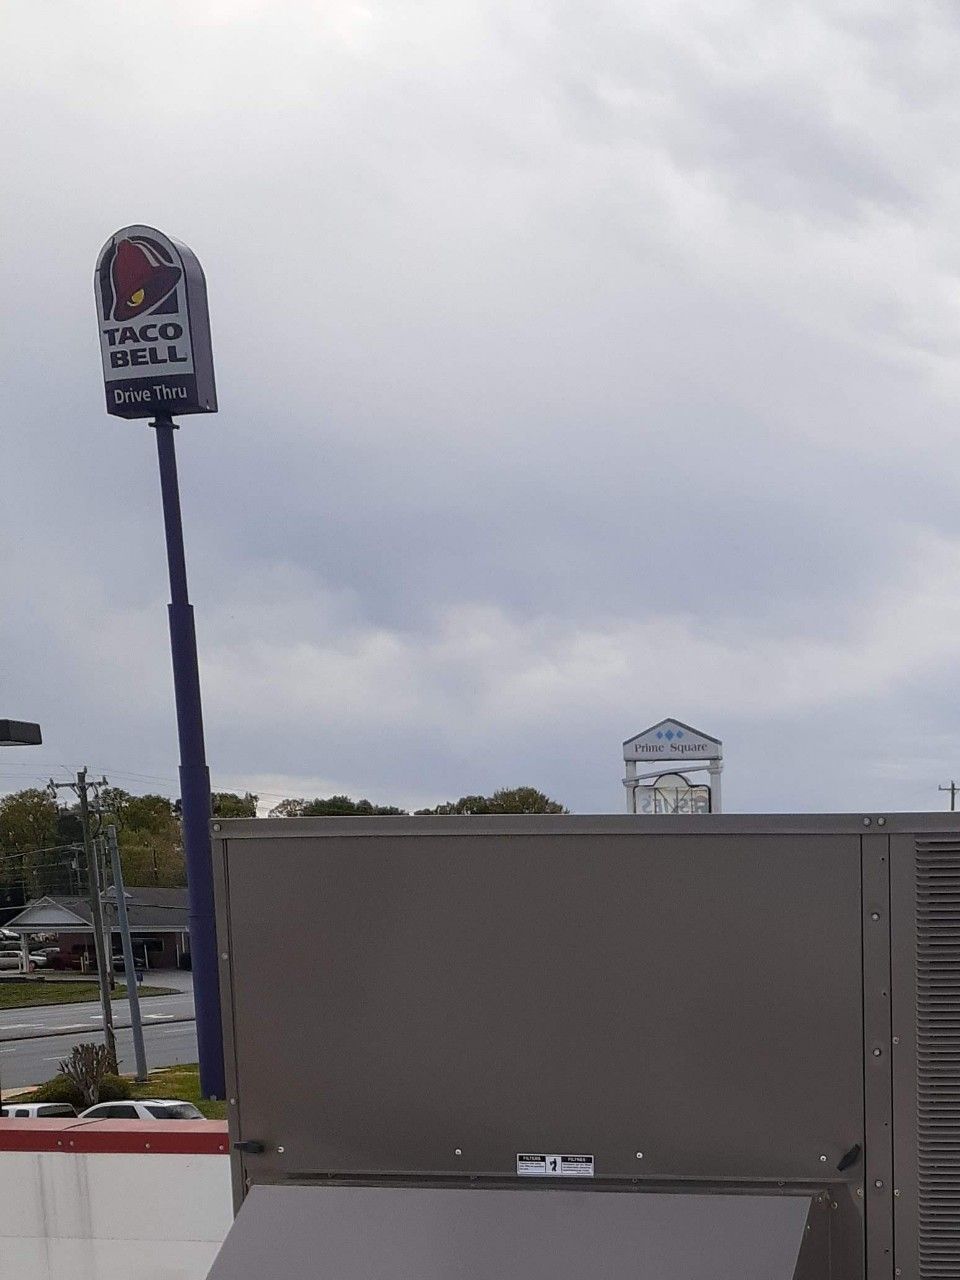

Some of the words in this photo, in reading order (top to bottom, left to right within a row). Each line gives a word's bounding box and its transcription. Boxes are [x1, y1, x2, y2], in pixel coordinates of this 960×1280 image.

[103, 322, 183, 346] TACO
[110, 346, 188, 369] BELL
[114, 388, 151, 404] Drive
[153, 385, 188, 401] Thru
[634, 743, 665, 753] Prime
[670, 743, 708, 754] Square
